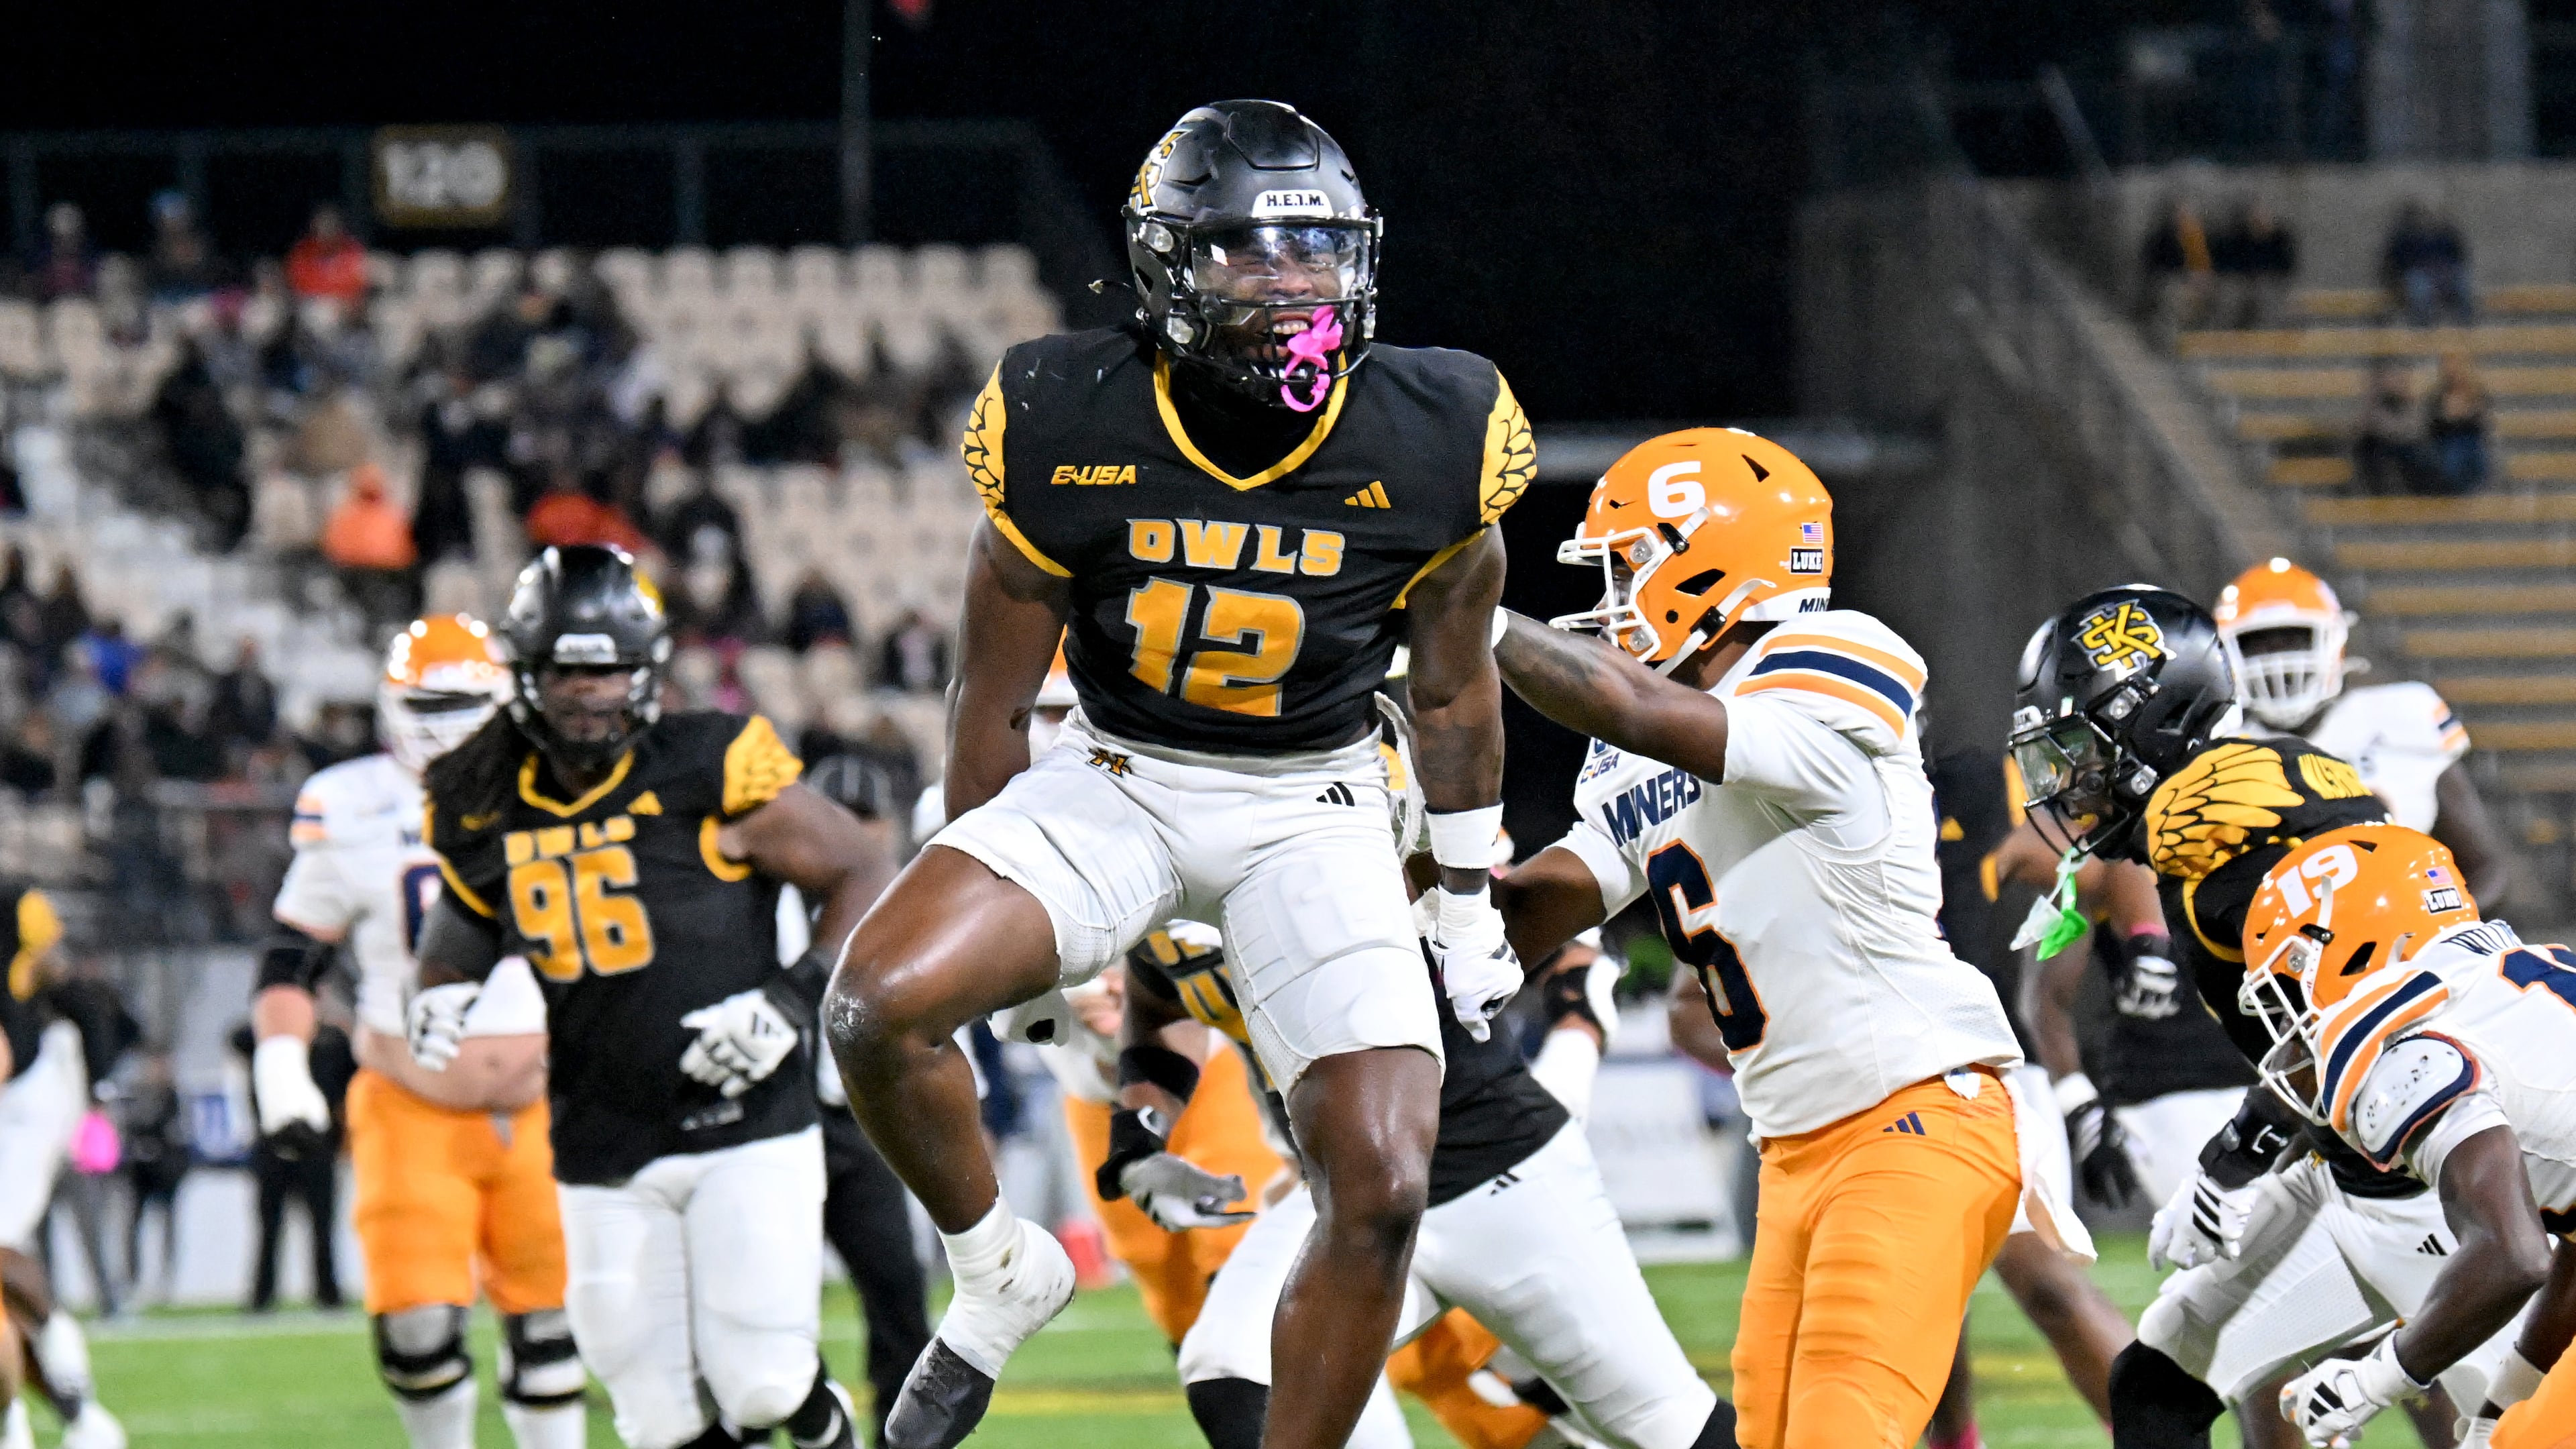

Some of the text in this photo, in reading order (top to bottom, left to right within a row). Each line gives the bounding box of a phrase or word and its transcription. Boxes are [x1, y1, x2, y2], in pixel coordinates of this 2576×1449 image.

[1648, 461, 1705, 518] 6
[1127, 519, 1346, 576] OWLS
[1792, 551, 1823, 570] LUKE
[1126, 576, 1306, 716] 12
[506, 844, 658, 984] 96
[2276, 845, 2359, 920] 19
[1647, 838, 1770, 1055] 6
